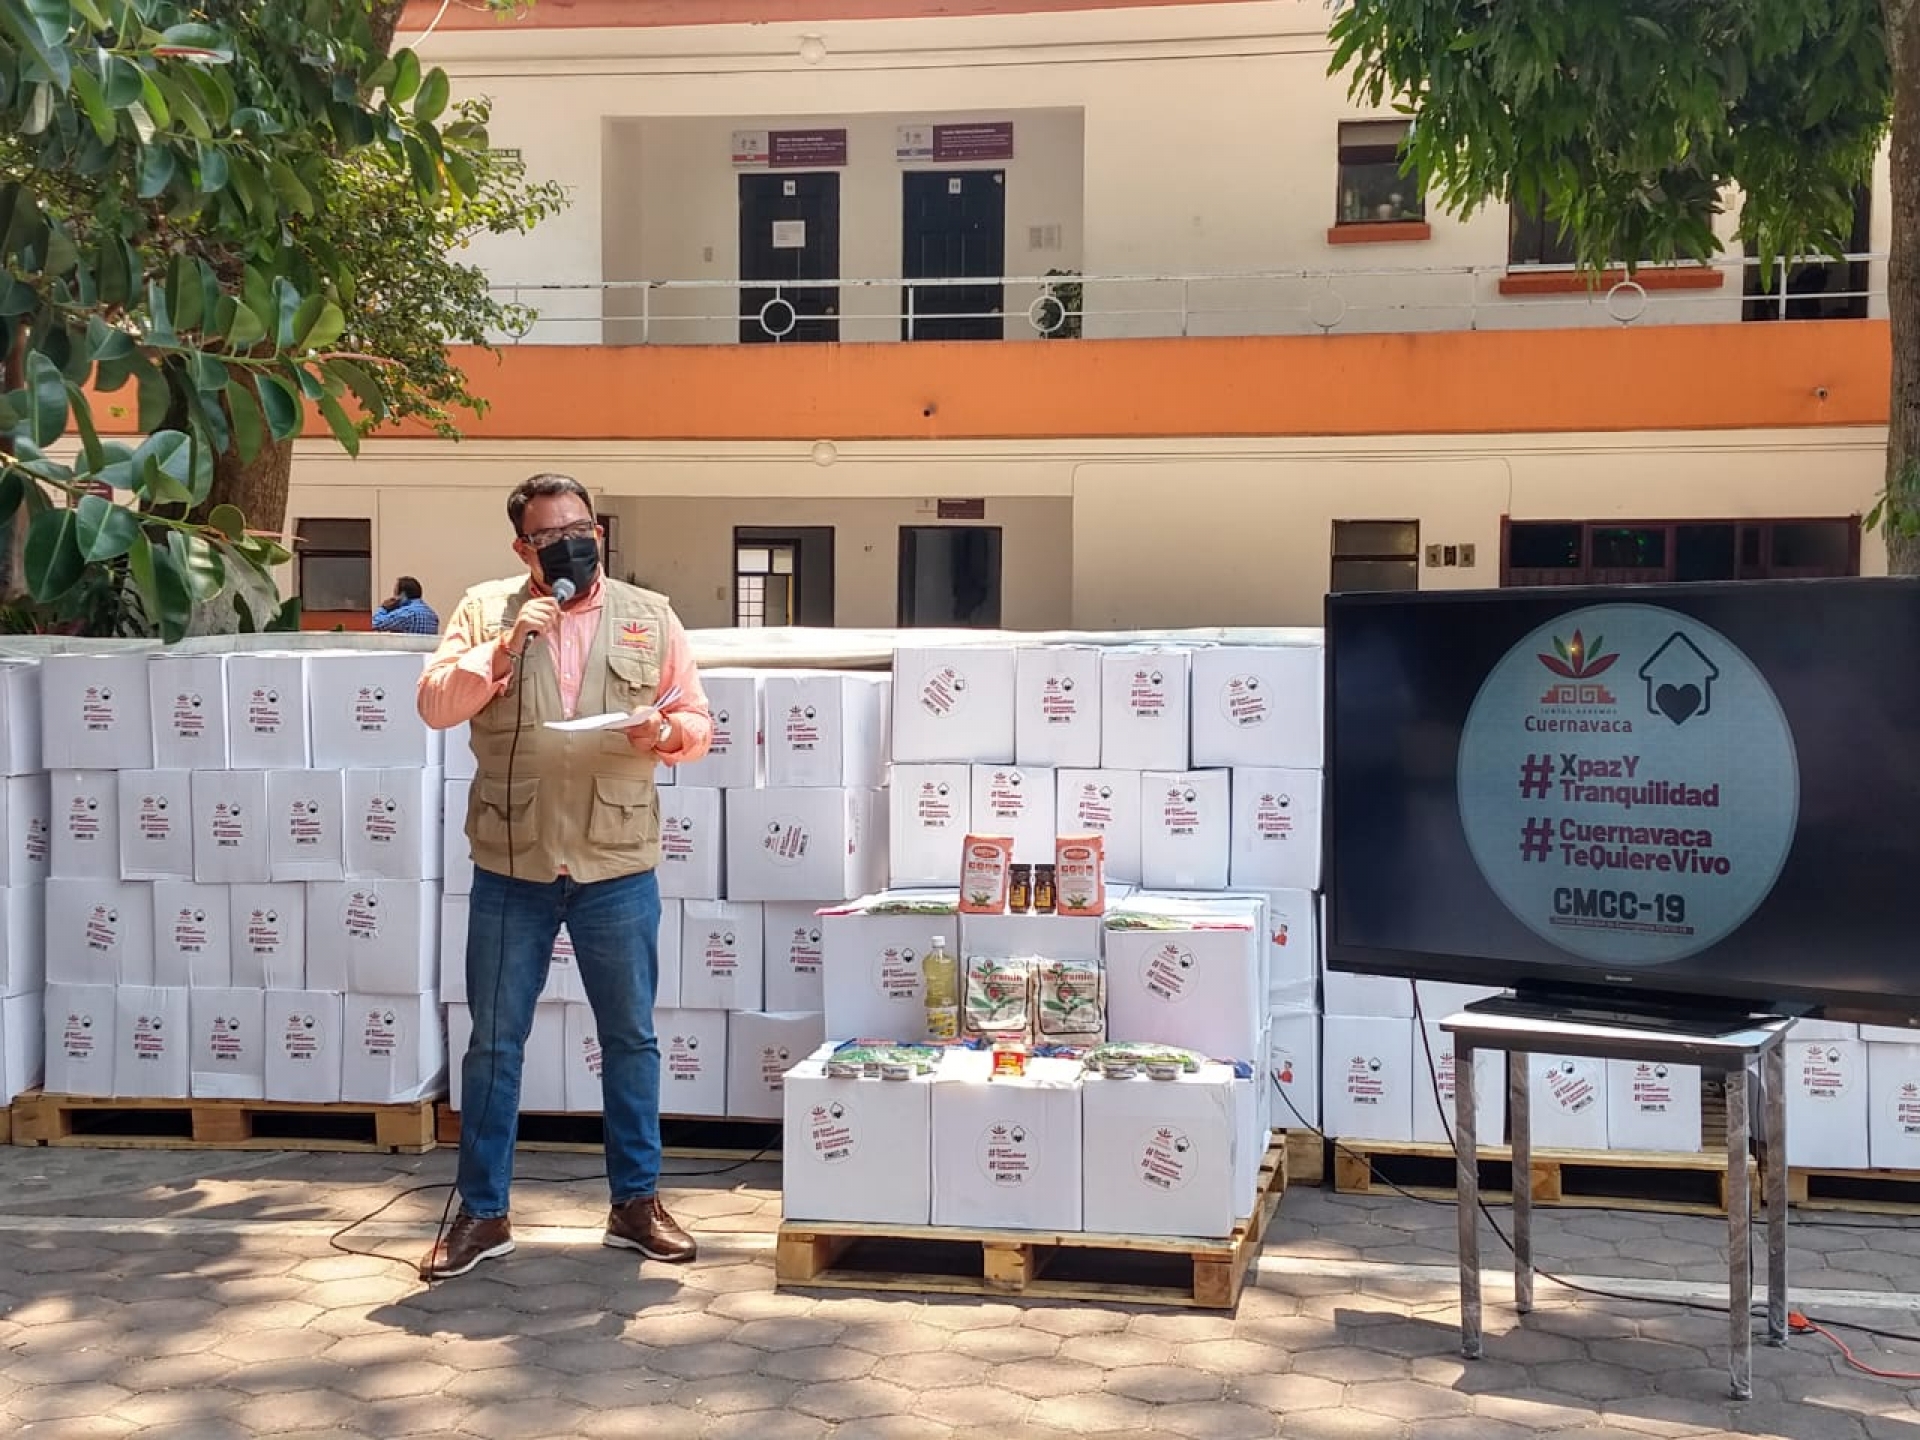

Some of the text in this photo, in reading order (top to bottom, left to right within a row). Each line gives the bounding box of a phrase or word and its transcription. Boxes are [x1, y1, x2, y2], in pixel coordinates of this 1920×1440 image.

[1524, 715, 1633, 733] Cuernavaca
[1559, 753, 1640, 783] XpazY
[1559, 779, 1720, 809] Tranquilidad
[1559, 818, 1713, 848] Cuernavaca
[1559, 843, 1731, 876] TeQuiereVivo
[1553, 887, 1686, 923] CMCC-19
